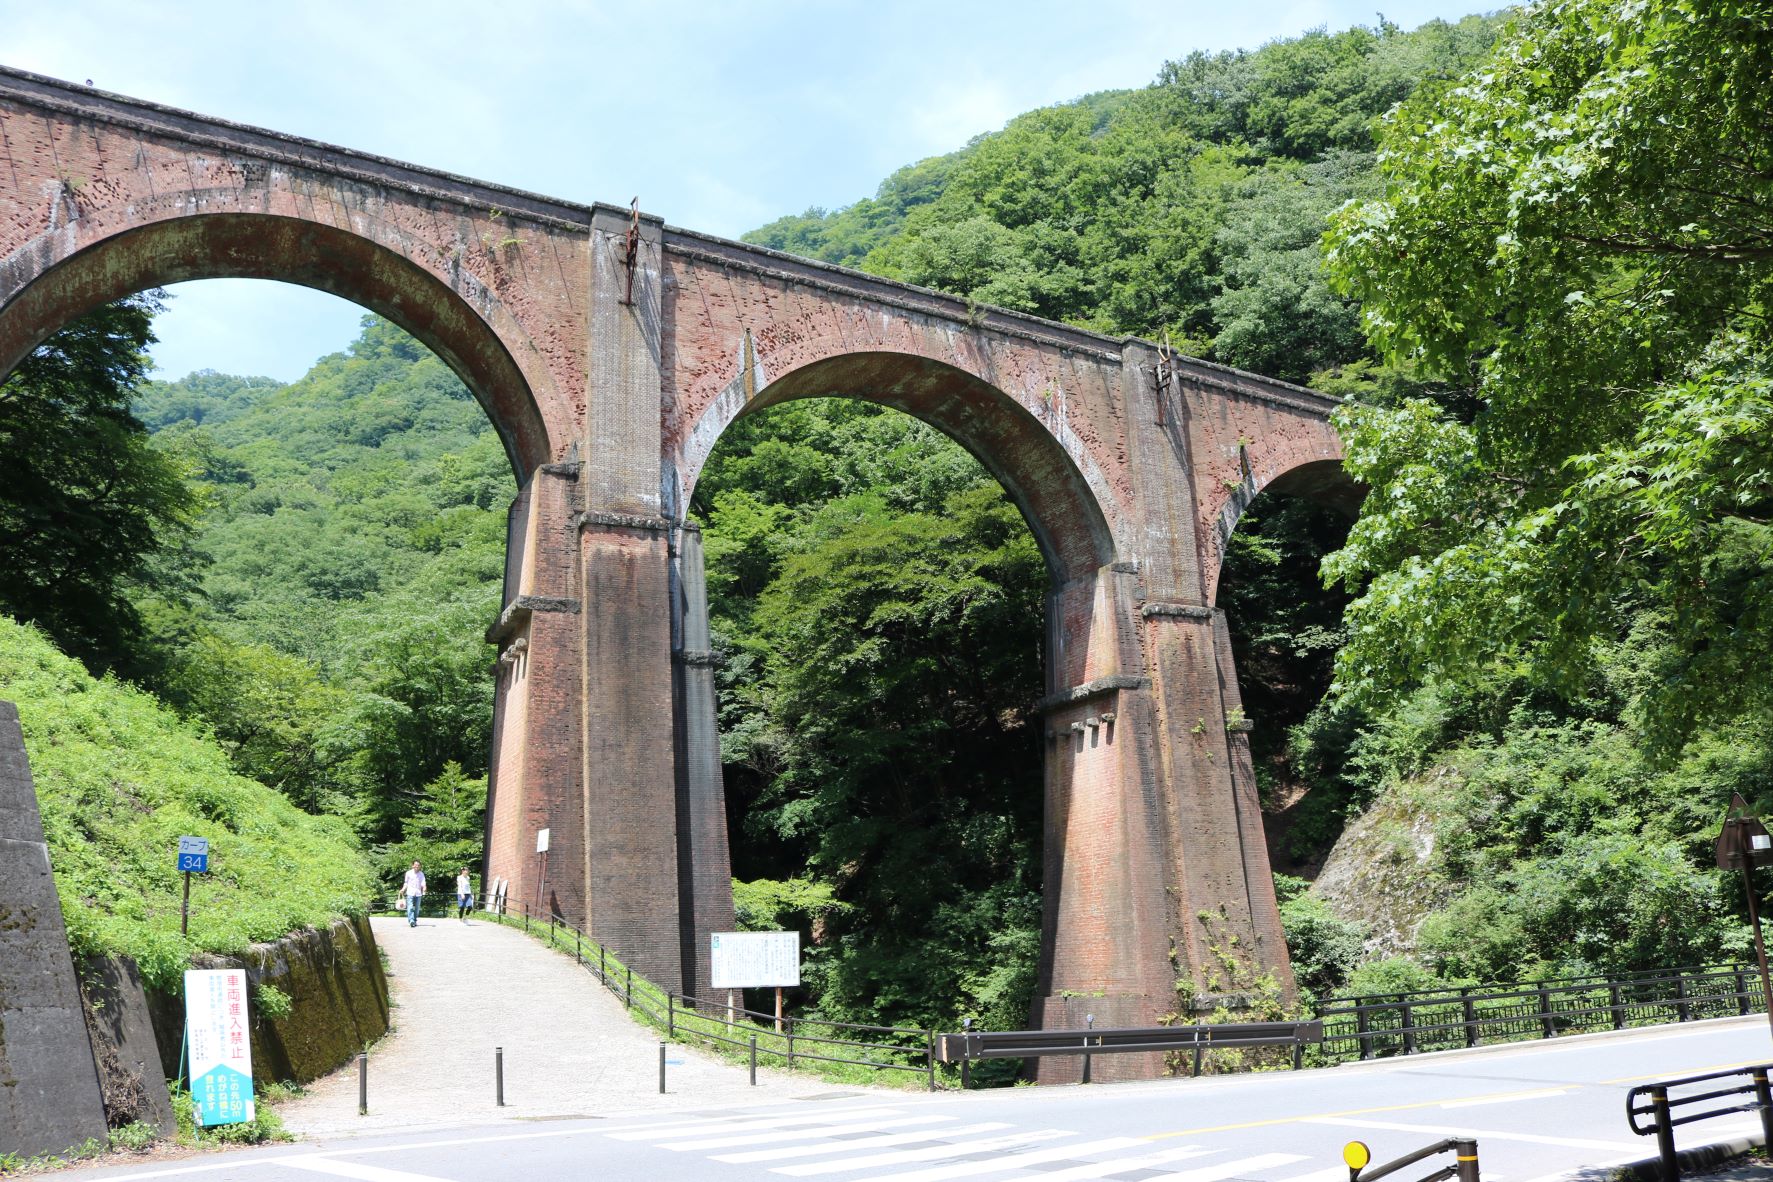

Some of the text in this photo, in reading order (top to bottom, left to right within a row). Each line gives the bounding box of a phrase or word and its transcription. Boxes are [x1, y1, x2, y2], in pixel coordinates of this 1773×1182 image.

[183, 856, 202, 869] 34
[227, 975, 244, 1058] 車両進入禁止
